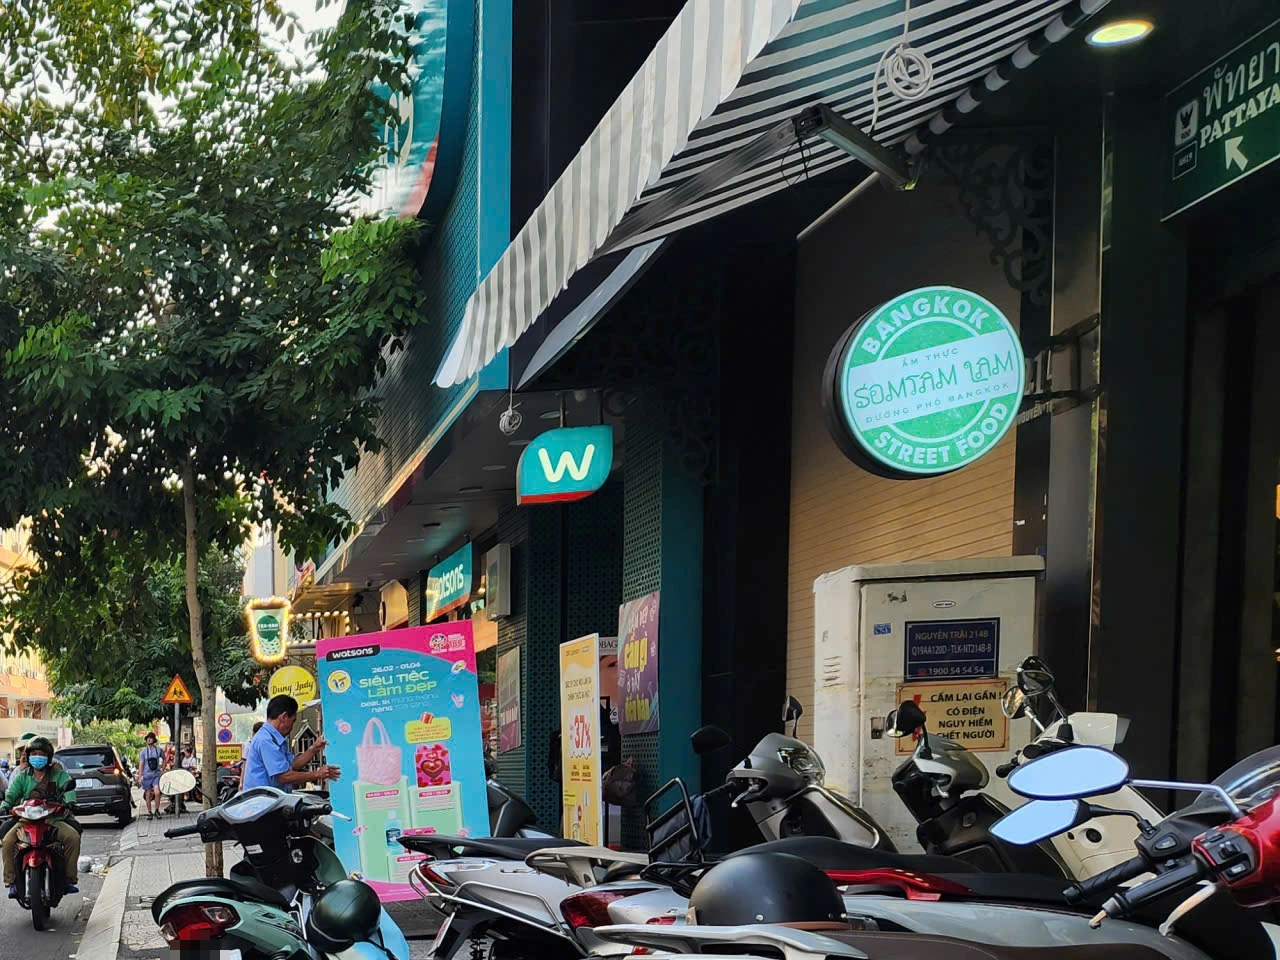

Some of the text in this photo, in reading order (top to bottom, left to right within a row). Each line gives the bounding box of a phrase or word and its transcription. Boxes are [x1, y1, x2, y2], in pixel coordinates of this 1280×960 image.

[1199, 82, 1280, 149] PATTAYA
[862, 295, 989, 355] BANGKOK
[948, 382, 1010, 402] BANGKOK
[874, 402, 1008, 465] STREET FOOD
[538, 444, 595, 483] W
[970, 630, 988, 639] 214B
[332, 647, 373, 659] watsons
[928, 666, 984, 676] 1900 54 54 54
[930, 691, 953, 703] CẤM
[956, 692, 972, 704] LẠI
[947, 706, 985, 717] CÓ ĐIỆN
[938, 717, 993, 729] NGUY HIỂM
[963, 730, 995, 740] NGƯỜI
